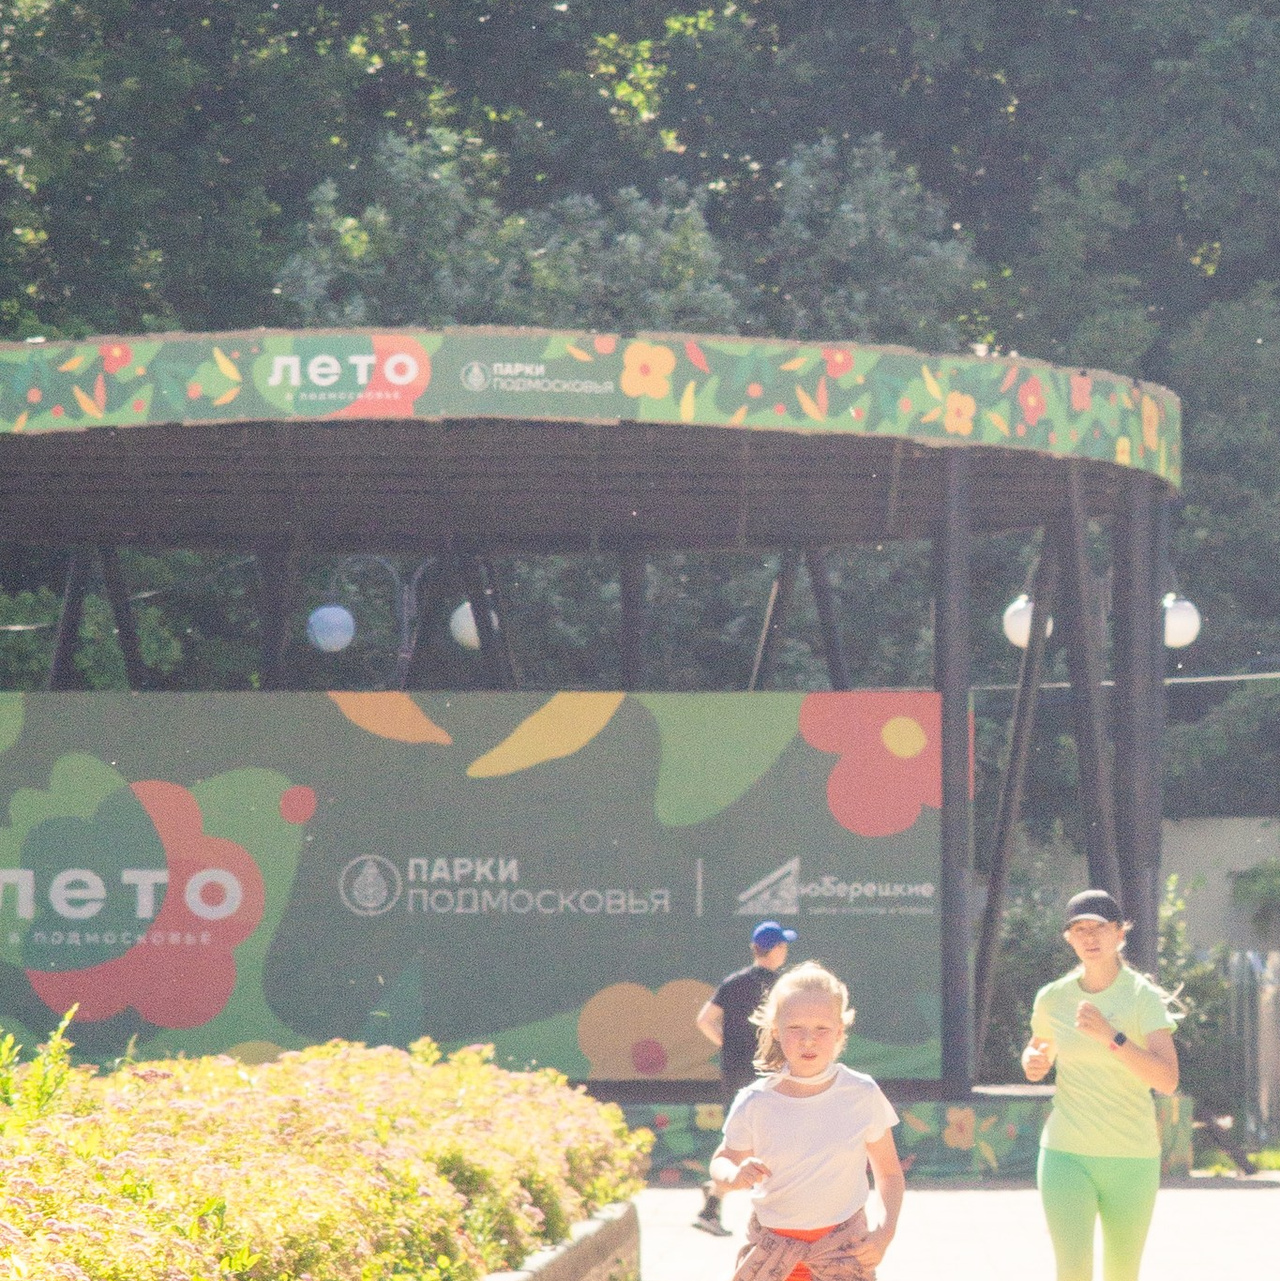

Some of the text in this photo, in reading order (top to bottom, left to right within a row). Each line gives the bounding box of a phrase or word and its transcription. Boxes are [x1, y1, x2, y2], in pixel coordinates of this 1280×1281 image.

[267, 353, 420, 387] лето
[492, 362, 546, 377] ПАРКИ
[407, 857, 520, 883] ПАРКИ
[407, 888, 671, 915] ПОДМОСКОВЬЯ
